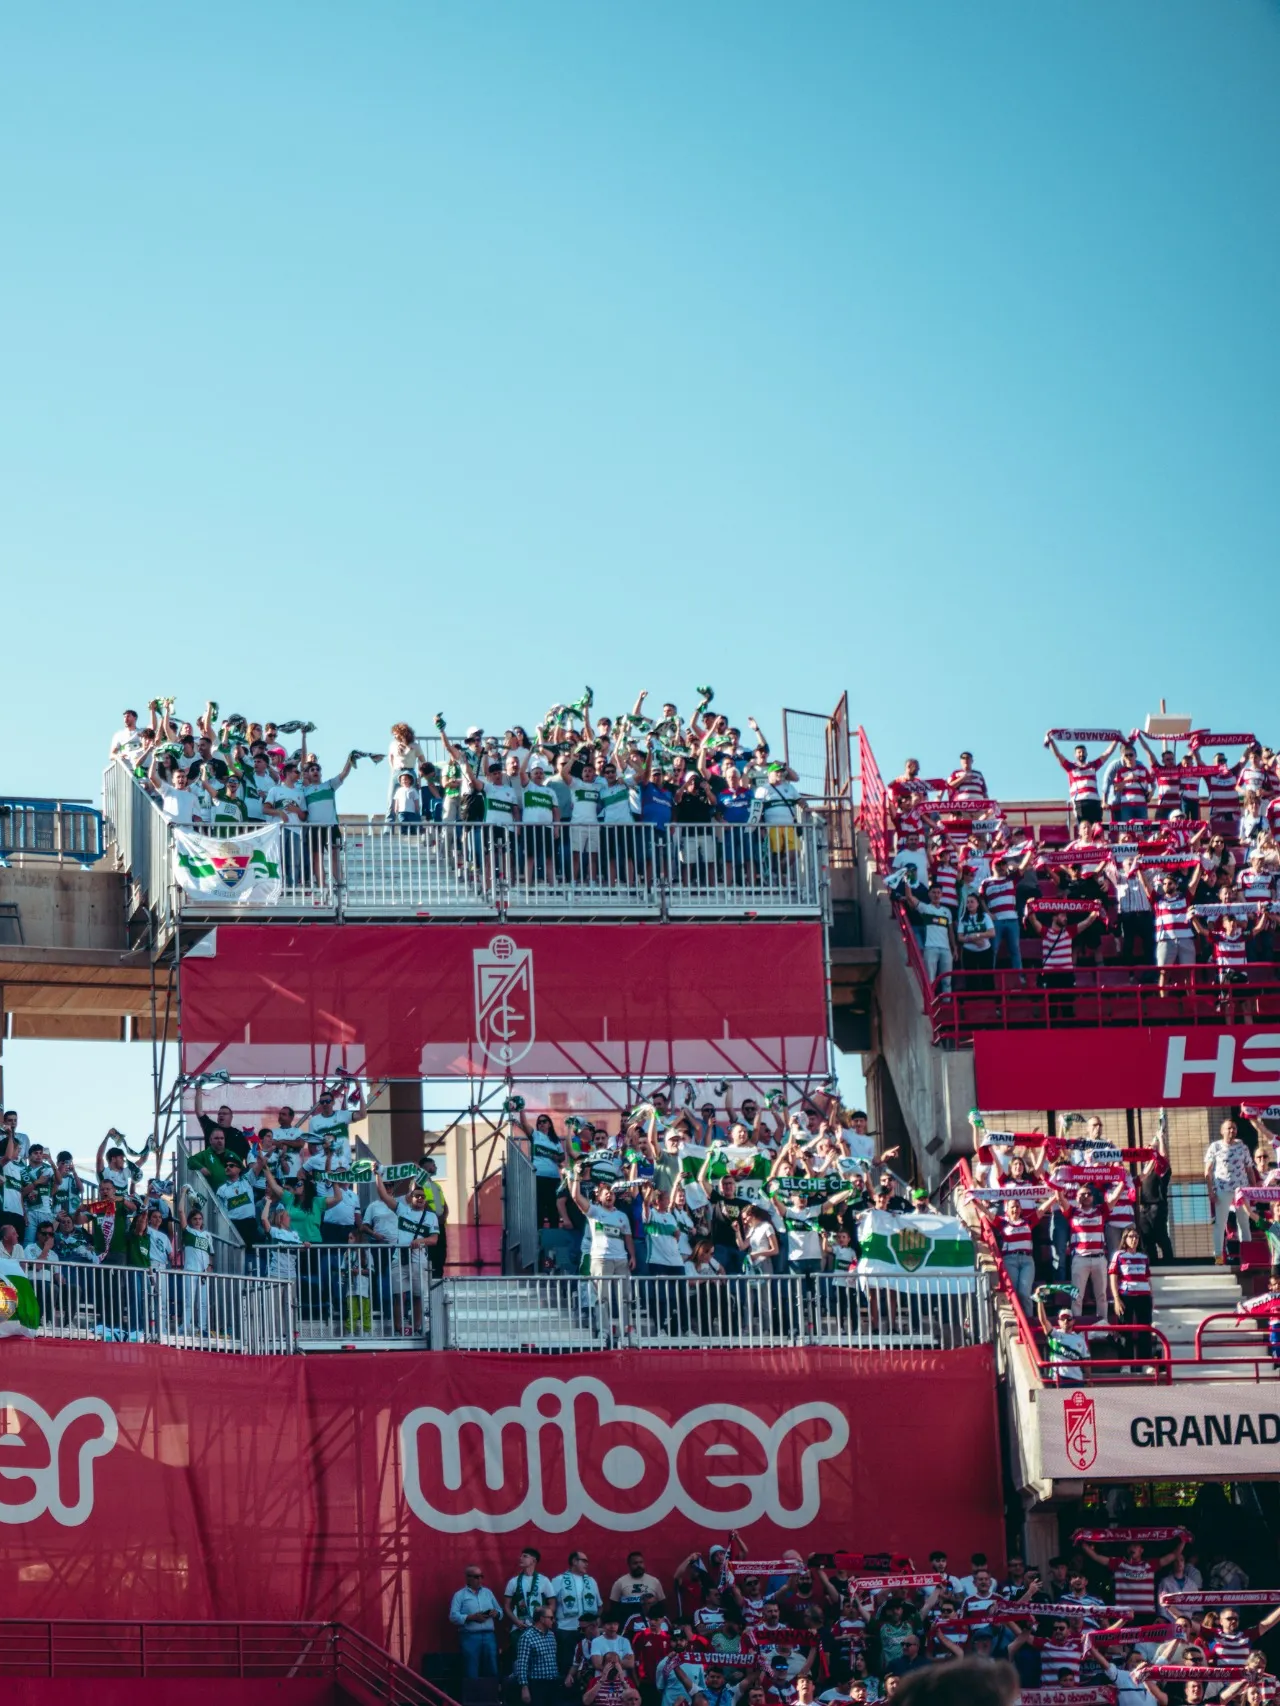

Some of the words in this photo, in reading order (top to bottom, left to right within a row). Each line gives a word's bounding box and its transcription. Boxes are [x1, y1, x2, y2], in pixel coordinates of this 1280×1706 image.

[782, 1178, 826, 1190] ELCHE
[829, 1178, 847, 1190] CF
[399, 1376, 849, 1533] wiber
[704, 1652, 755, 1665] GRANADA
